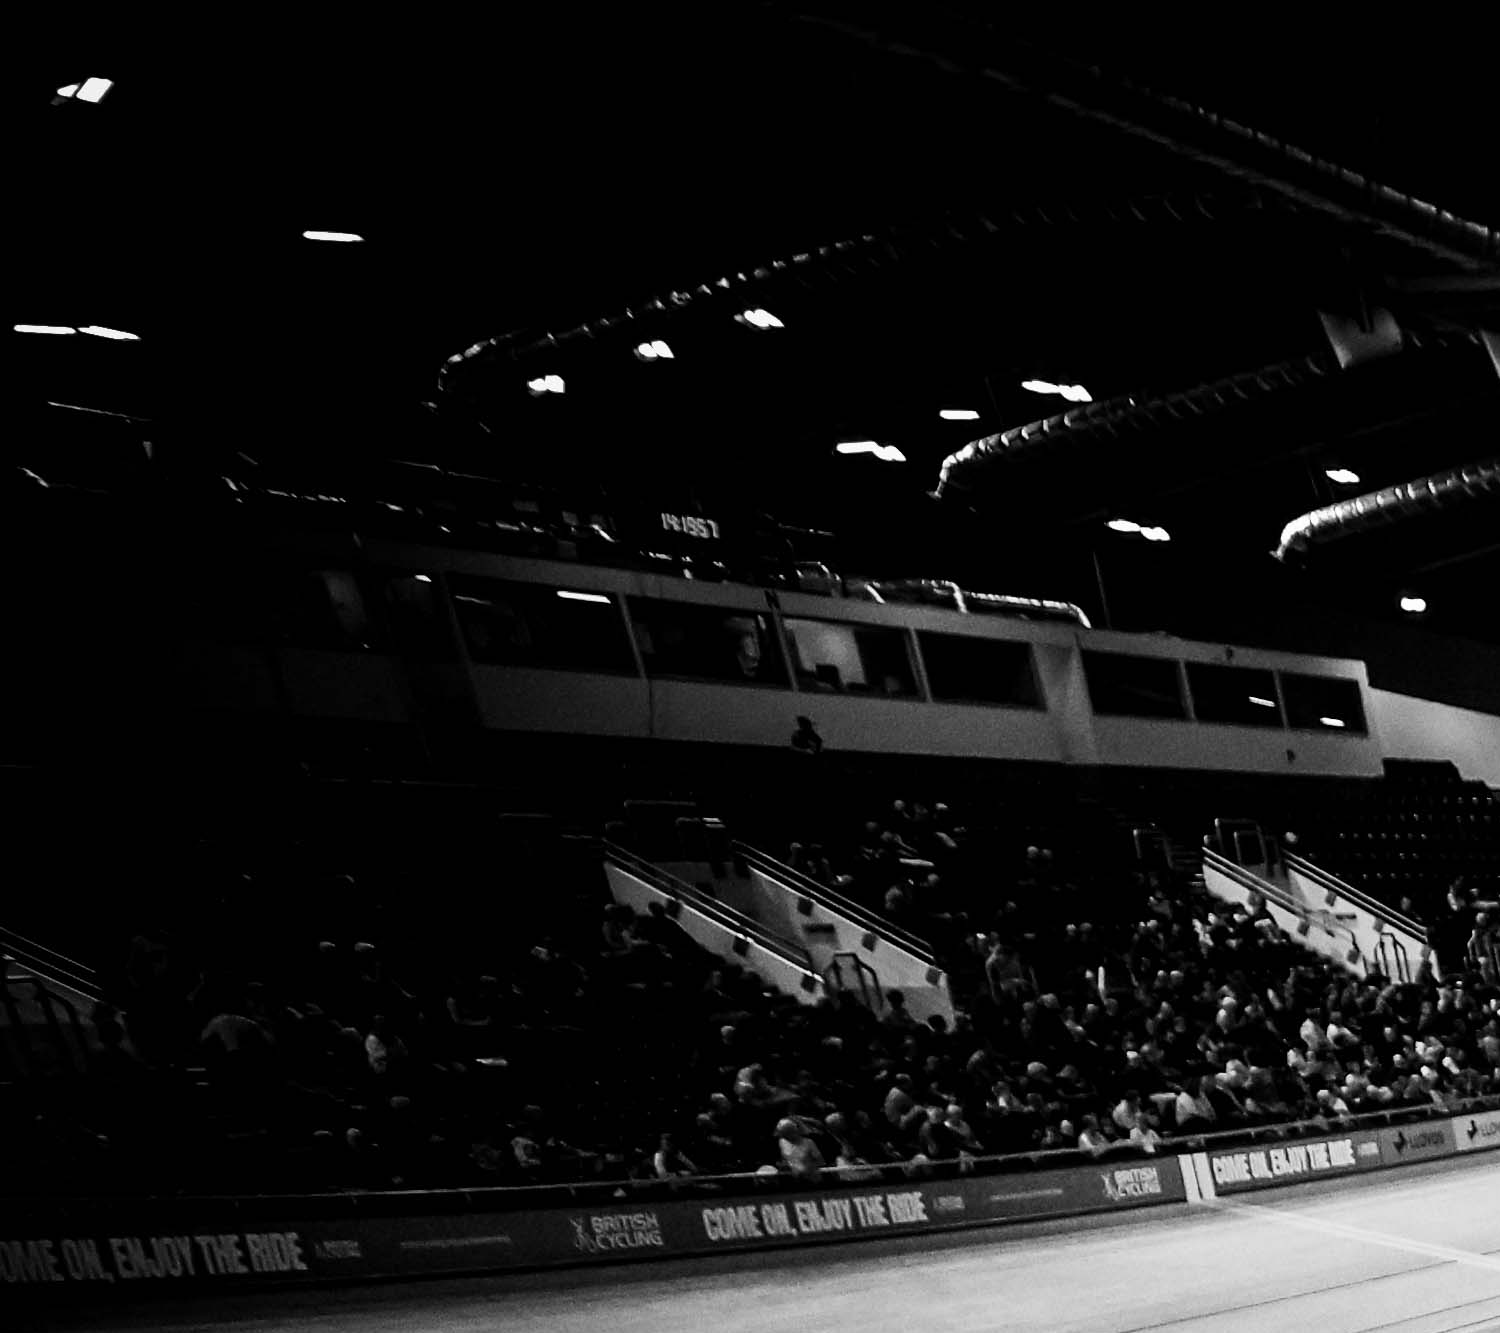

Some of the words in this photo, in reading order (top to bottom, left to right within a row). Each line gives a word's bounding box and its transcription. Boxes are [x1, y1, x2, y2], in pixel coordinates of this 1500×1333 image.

[1212, 1152, 1250, 1185] COME
[1269, 1145, 1308, 1179] ENJOY
[1307, 1142, 1329, 1170] THE
[1328, 1138, 1357, 1167] RIDE
[1113, 1166, 1159, 1184] BRITISH
[1115, 1180, 1162, 1198] CYCLING
[590, 1212, 660, 1235] BRITISH
[702, 1204, 764, 1242] COME
[794, 1197, 856, 1233] ENJOY
[854, 1195, 889, 1227] THE
[886, 1190, 929, 1224] RIDE
[594, 1229, 664, 1251] CYCLING
[0, 1239, 65, 1283] OME
[108, 1234, 198, 1280] ENJOY
[194, 1234, 249, 1275] THE
[244, 1231, 310, 1273] RIDE
